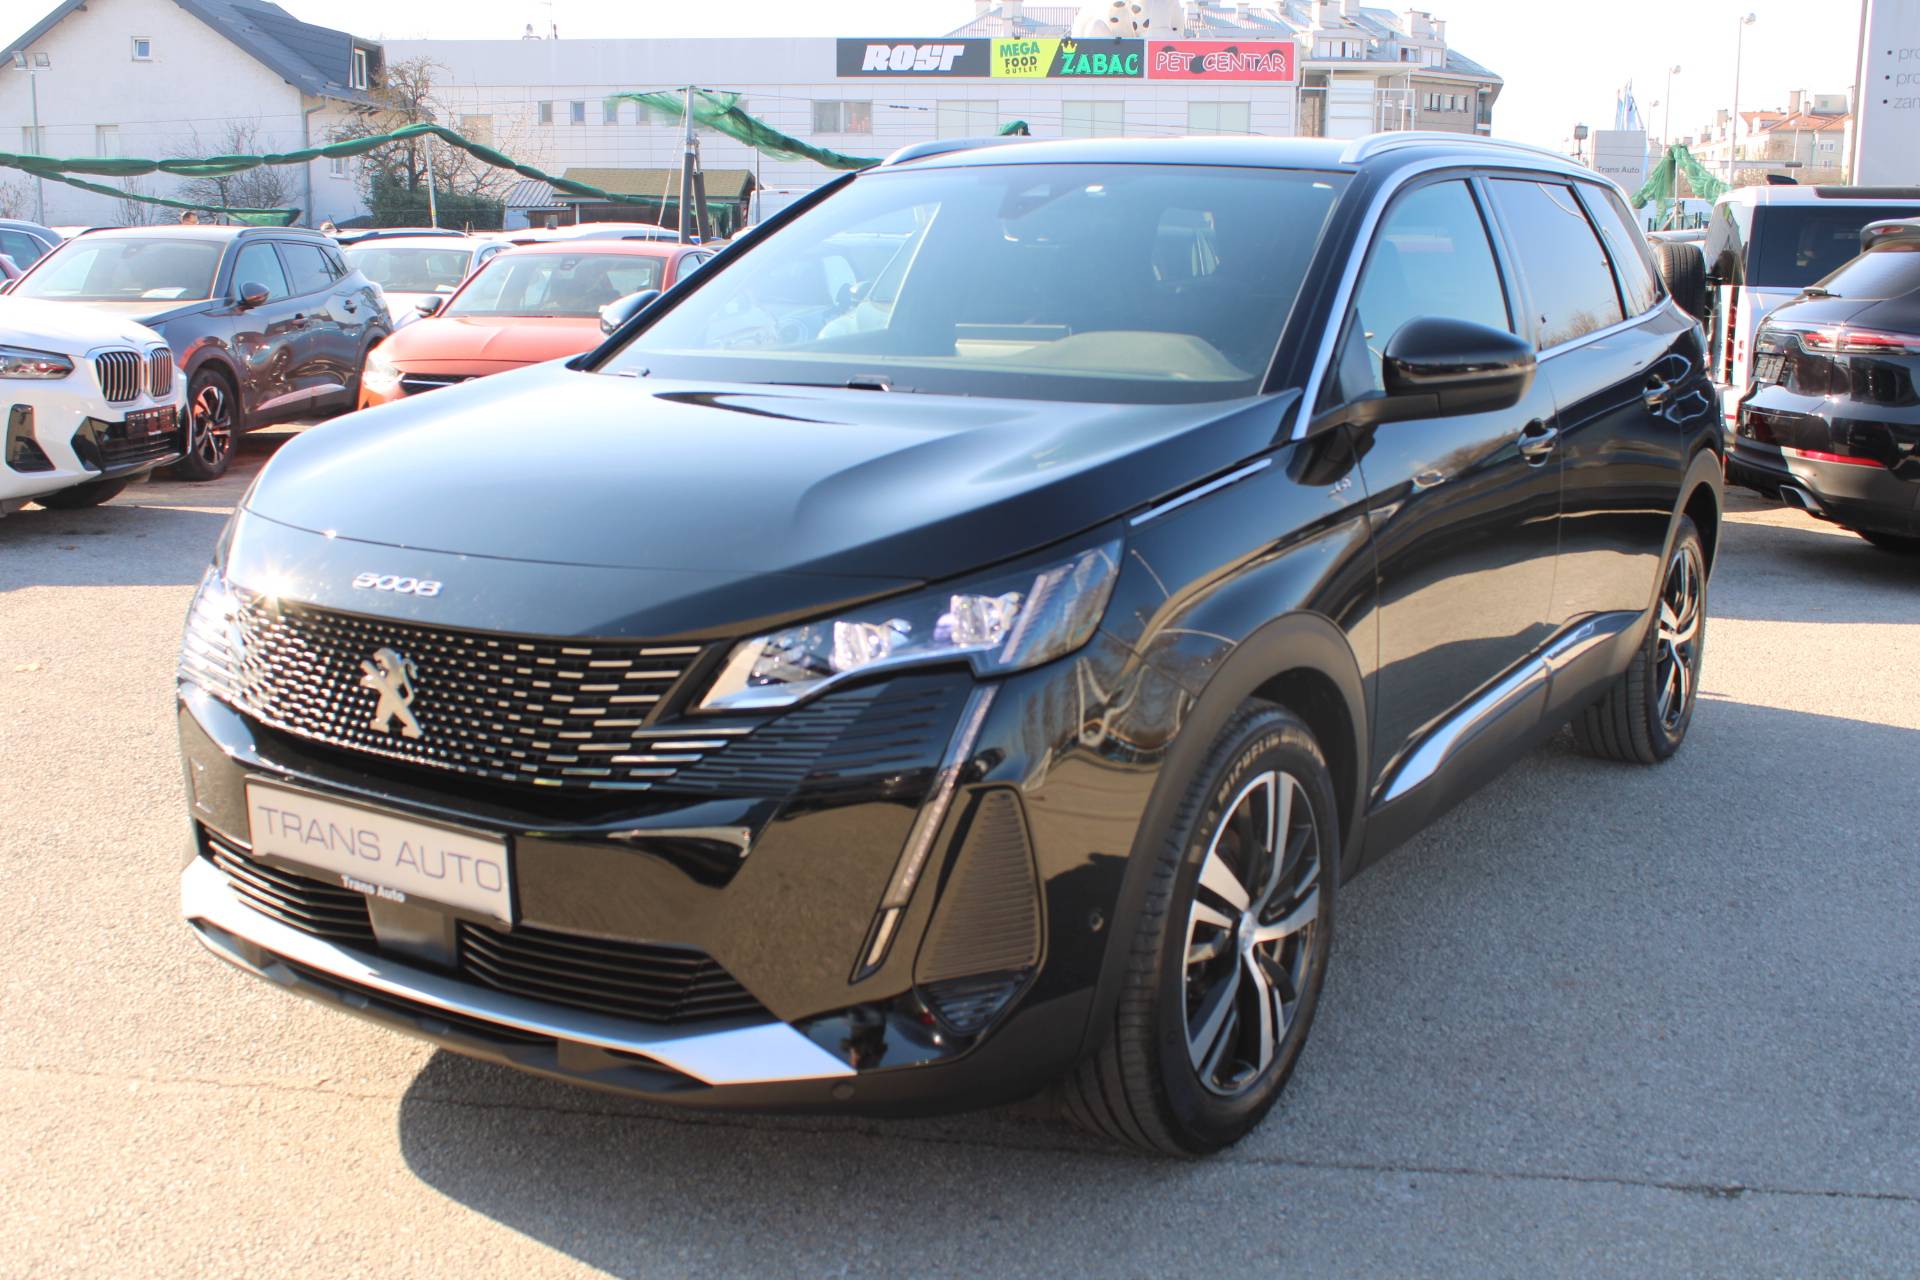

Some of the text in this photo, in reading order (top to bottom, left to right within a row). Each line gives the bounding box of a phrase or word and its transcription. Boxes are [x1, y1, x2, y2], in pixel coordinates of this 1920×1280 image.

[862, 44, 965, 71] ROST
[1000, 41, 1040, 58] MEGA
[1005, 55, 1037, 68] FOOD
[1005, 66, 1037, 75] OUTLET
[1156, 51, 1286, 72] PET CENTAR
[352, 572, 443, 597] 5008
[257, 805, 503, 893] TRANS AUTO
[340, 873, 406, 903] Trans Auto
